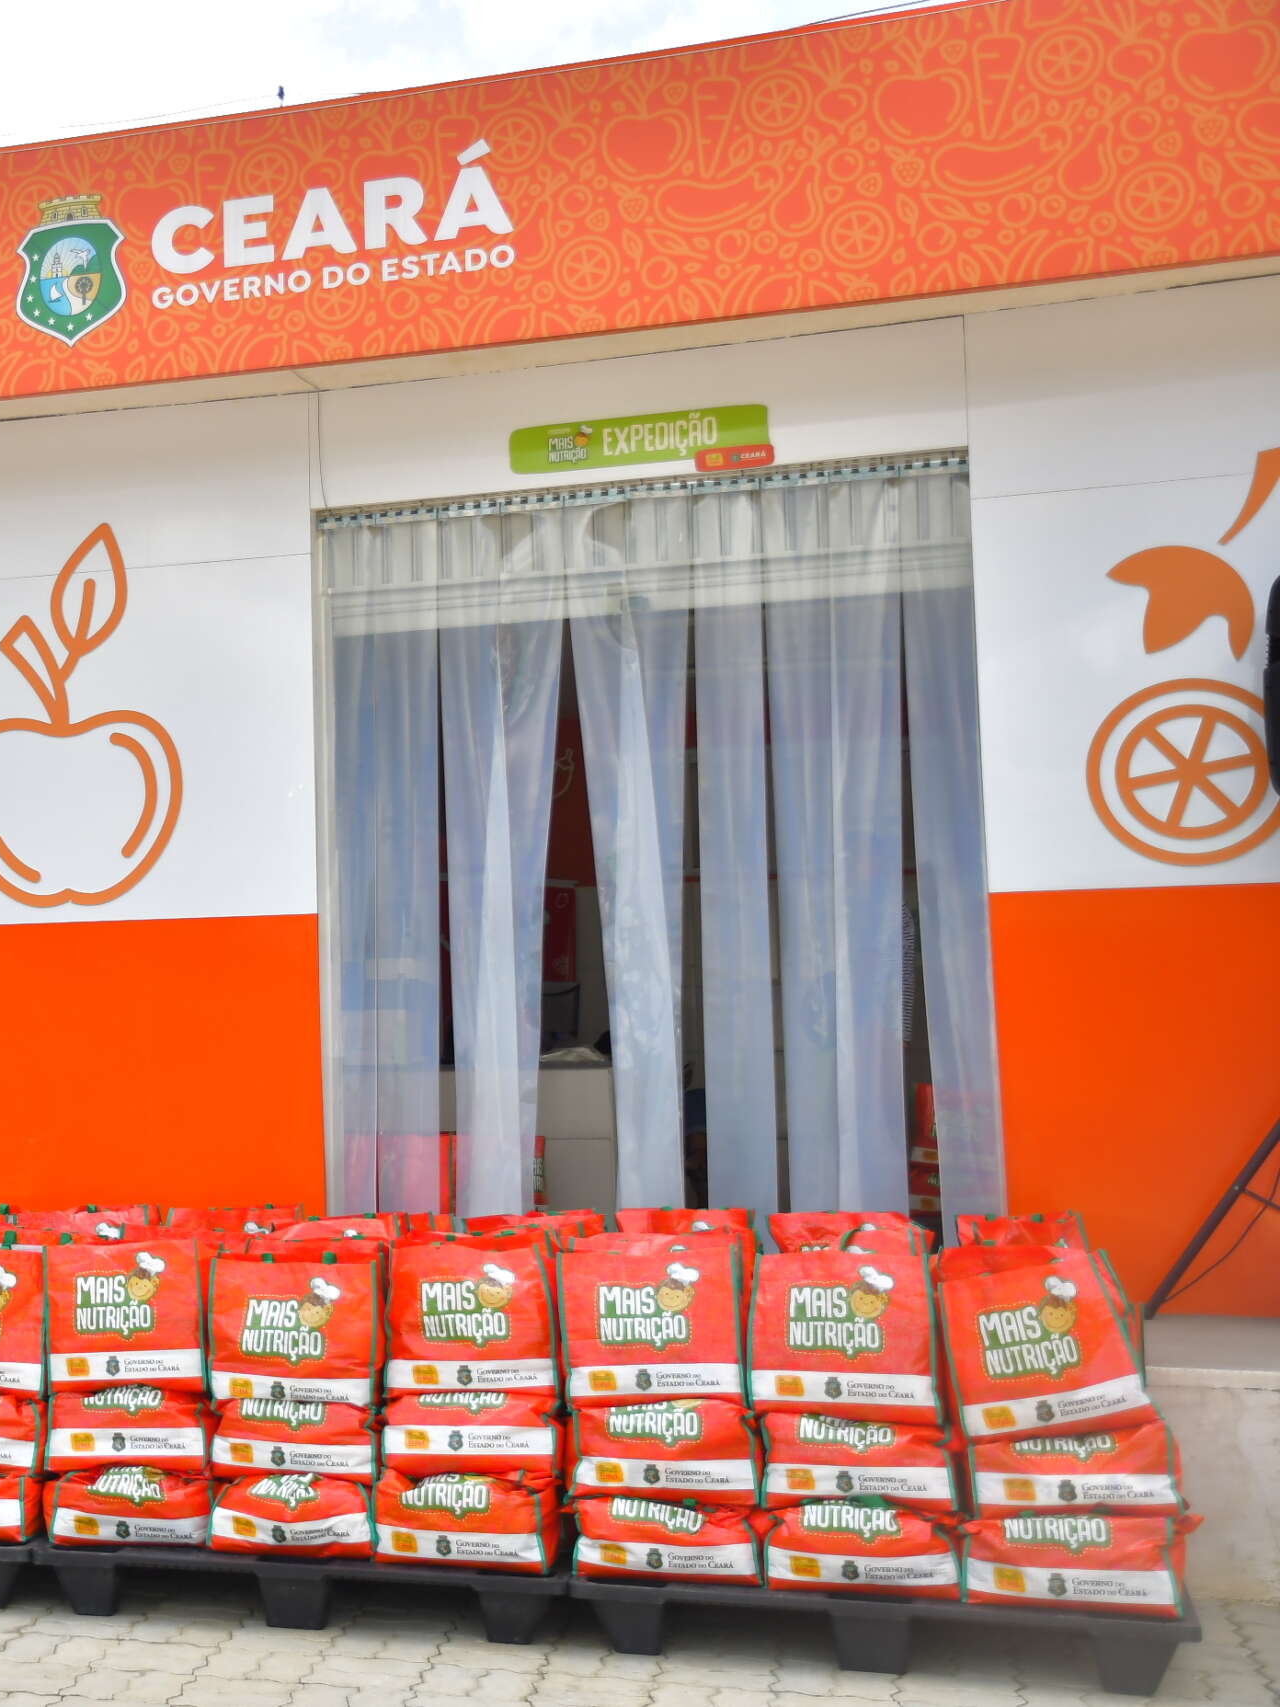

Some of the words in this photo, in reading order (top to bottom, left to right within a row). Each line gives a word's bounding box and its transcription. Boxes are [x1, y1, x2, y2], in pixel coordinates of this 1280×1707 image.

[151, 138, 514, 274] CEARÁ
[152, 270, 312, 309] GOVERNO
[323, 263, 371, 289] DO
[382, 244, 516, 282] ESTADO
[548, 435, 573, 451] MAIS
[602, 412, 718, 456] EXPEDIÇÃO
[77, 1276, 125, 1304] MAIS
[422, 1282, 474, 1311] MAIS
[600, 1286, 655, 1315] MAIS
[790, 1287, 846, 1317] MAIS
[77, 1302, 151, 1336] NUTRIÇÃO
[247, 1300, 297, 1327] MAIS
[424, 1308, 506, 1343] NUTRIÇÃO
[600, 1311, 686, 1345] NUTRIÇÃO
[979, 1308, 1040, 1345] MAIS
[242, 1327, 321, 1360] NUTRIÇÃO
[790, 1317, 879, 1353] NUTRIÇÃO
[986, 1333, 1077, 1374] NUTRIÇÃO
[609, 1410, 697, 1444] NUTRIÇÃO
[89, 1473, 160, 1503] UTRIÇÃO
[1004, 1517, 1105, 1548] NUTRIÇÃO
